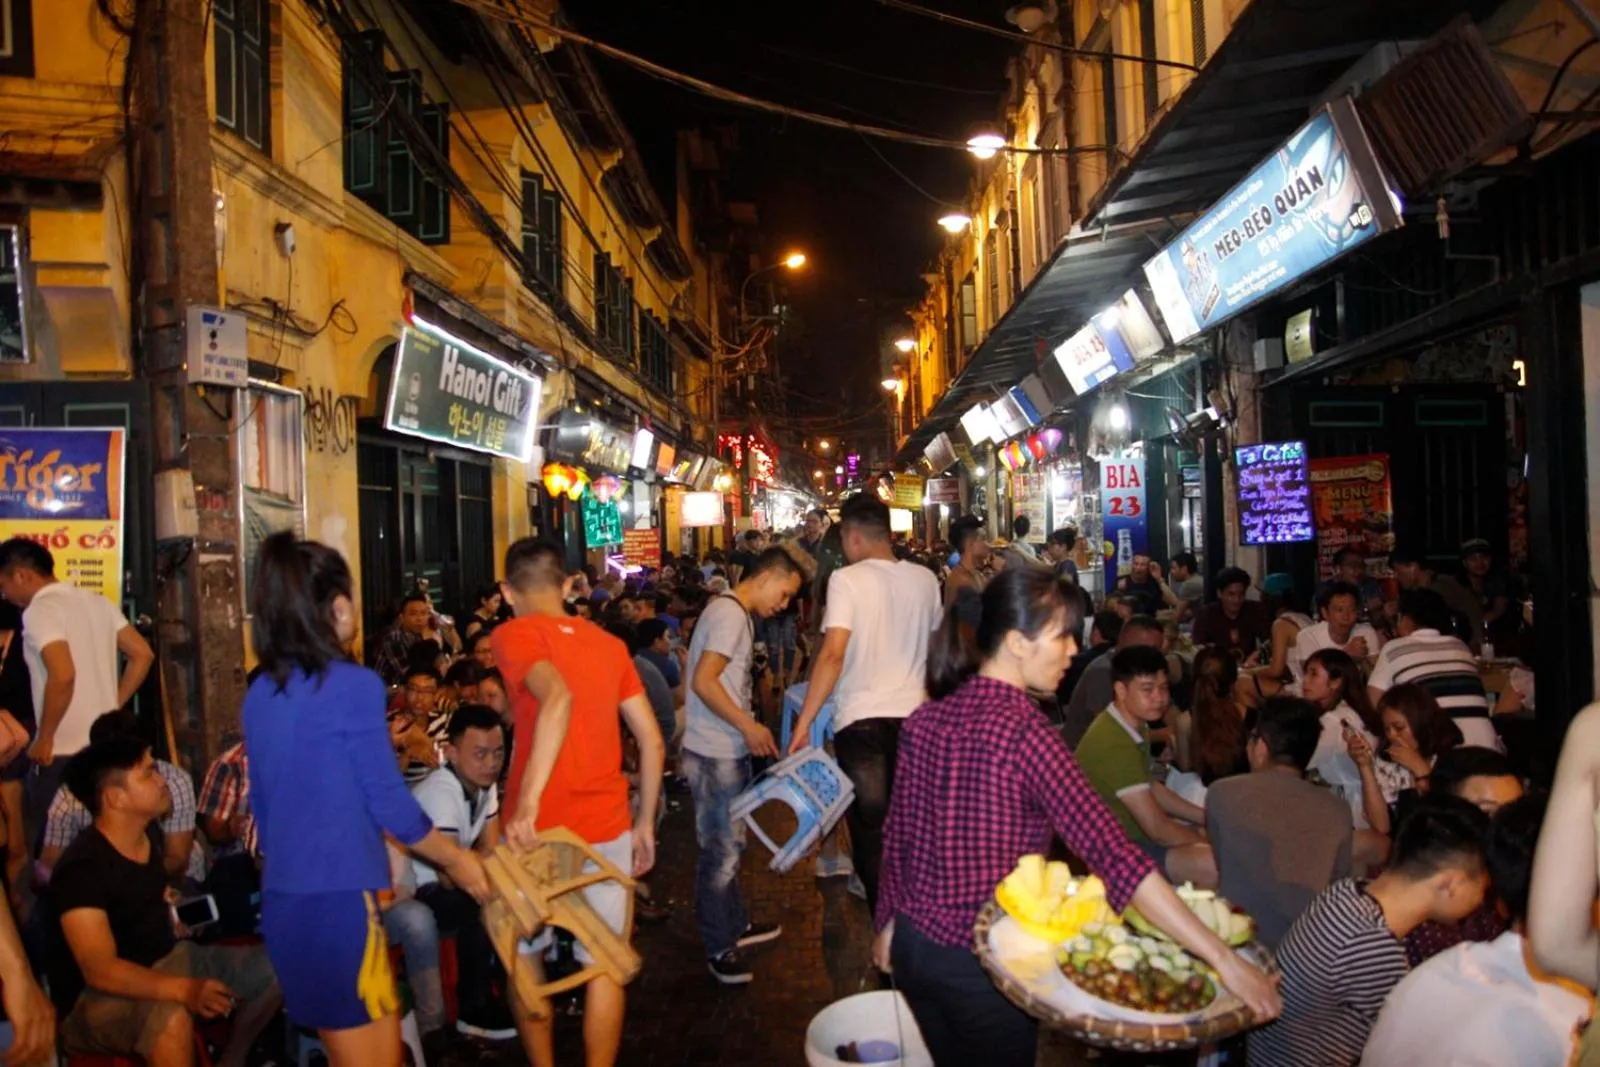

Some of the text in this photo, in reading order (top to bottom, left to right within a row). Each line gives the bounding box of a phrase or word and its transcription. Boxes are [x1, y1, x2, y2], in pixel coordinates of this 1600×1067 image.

[439, 344, 522, 417] Hanoi Gift
[1106, 464, 1141, 489] BIA
[1108, 496, 1142, 517] 23
